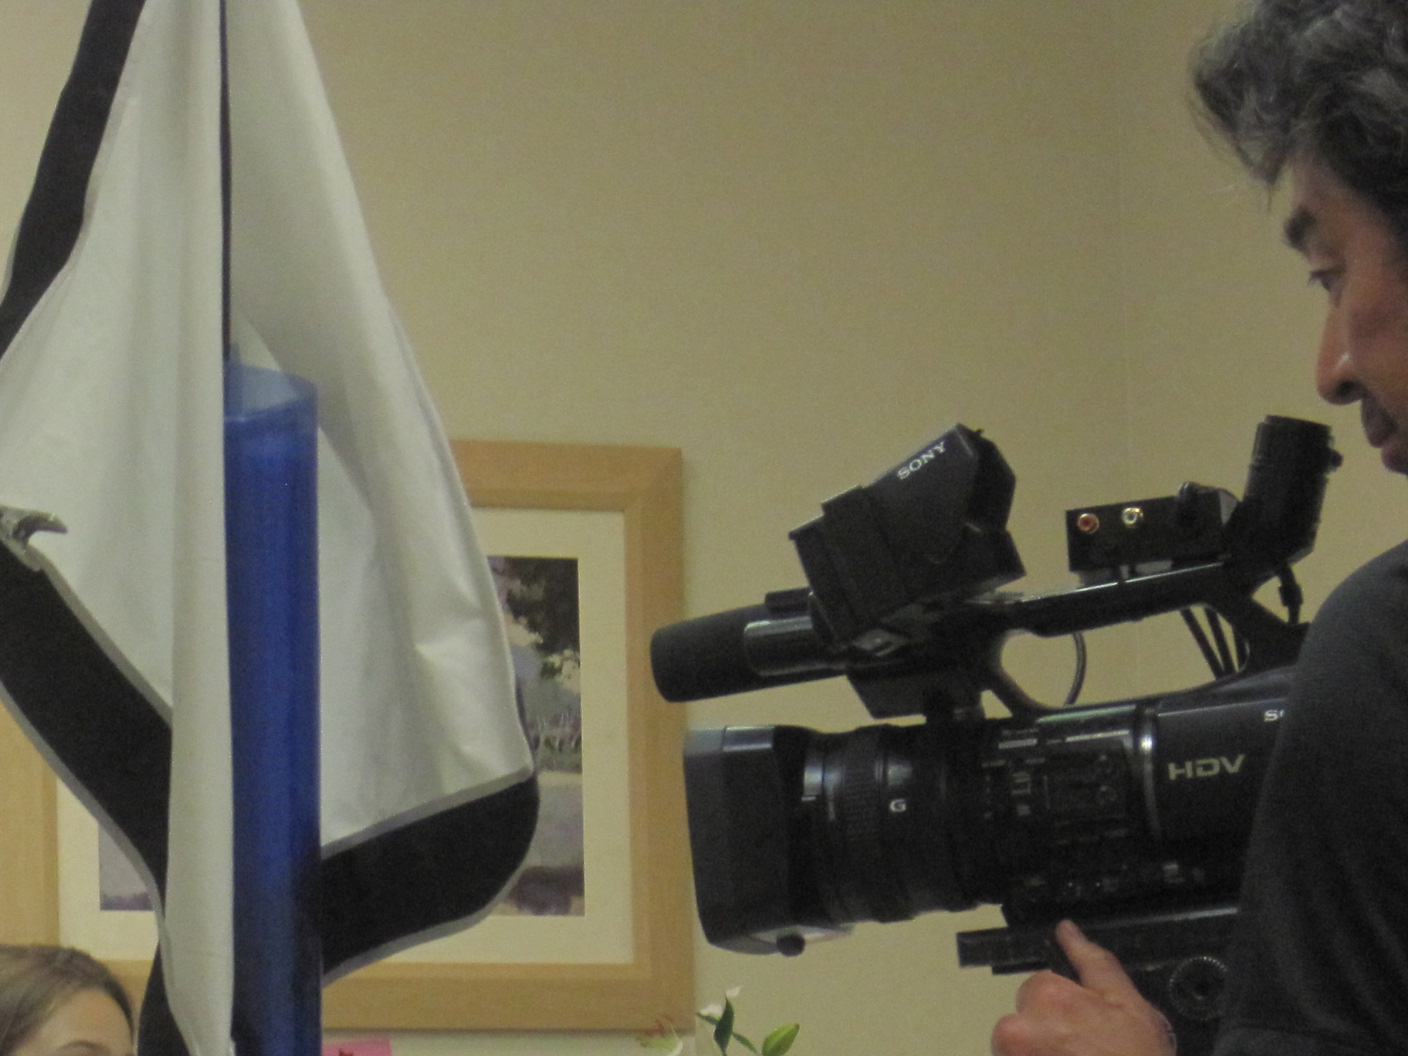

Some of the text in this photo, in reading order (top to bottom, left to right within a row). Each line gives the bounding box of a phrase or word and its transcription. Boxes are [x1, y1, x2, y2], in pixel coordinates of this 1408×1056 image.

[897, 440, 946, 480] SONY
[1263, 709, 1284, 722] S
[1167, 753, 1246, 781] HDV
[889, 799, 907, 812] G
